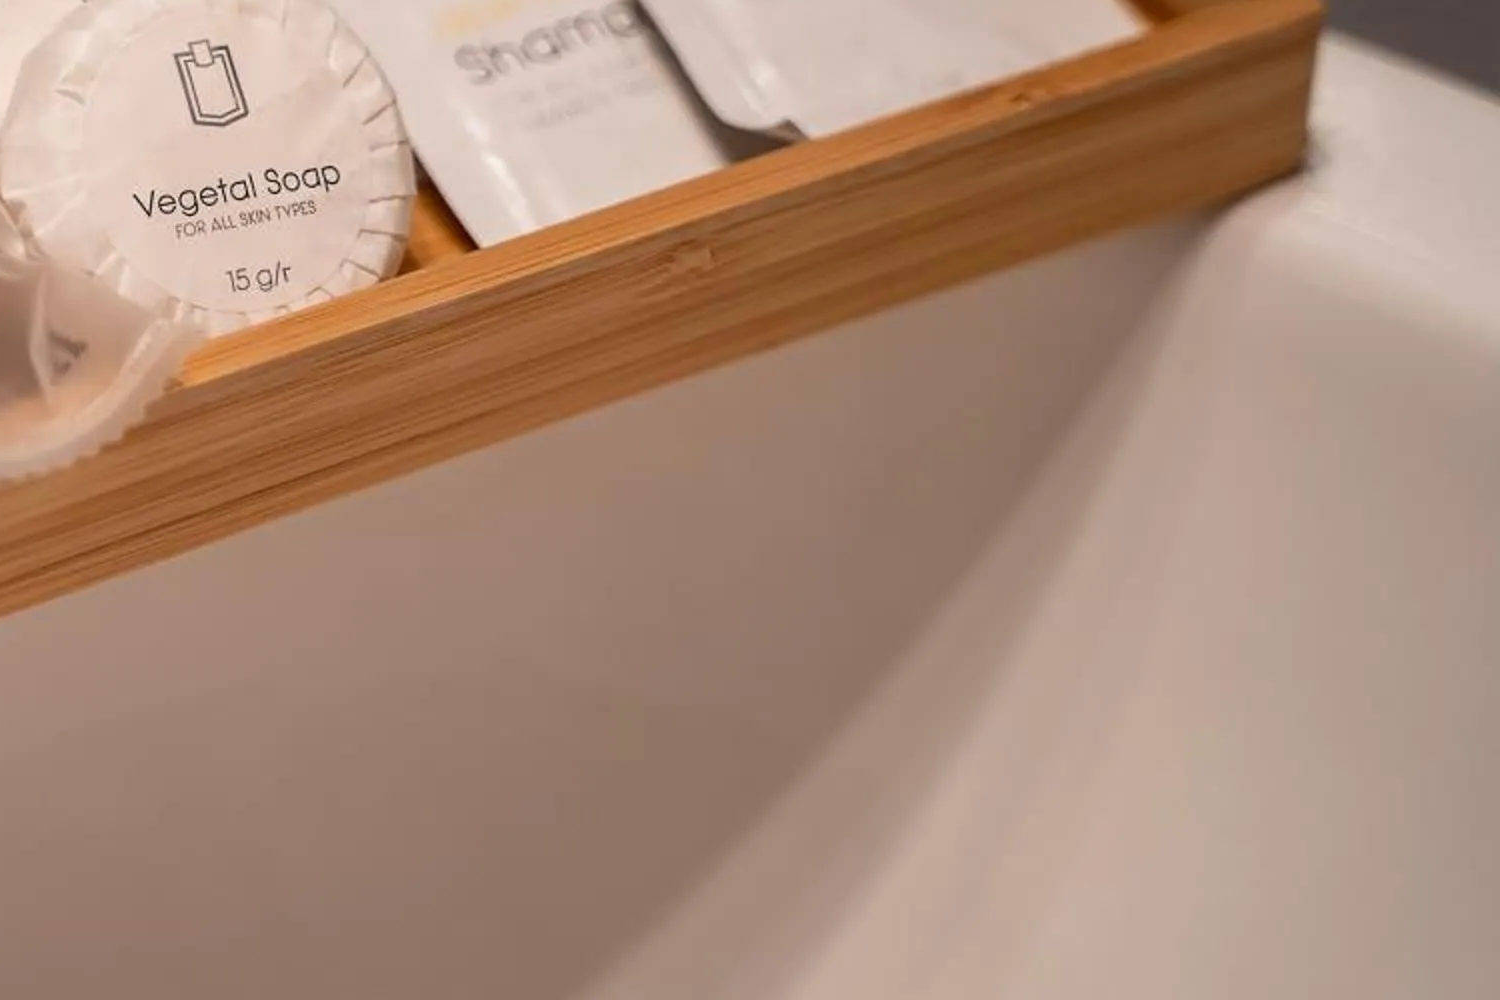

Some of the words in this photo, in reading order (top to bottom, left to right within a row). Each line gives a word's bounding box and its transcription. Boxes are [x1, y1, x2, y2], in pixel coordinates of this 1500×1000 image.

[132, 172, 258, 218] Vegetal
[264, 164, 341, 196] Soap
[175, 219, 208, 239] FOR
[211, 214, 237, 233] ALL
[240, 207, 272, 227] SKIN
[276, 199, 318, 221] TYPES
[225, 267, 251, 293] 15
[256, 260, 292, 293] g/r
